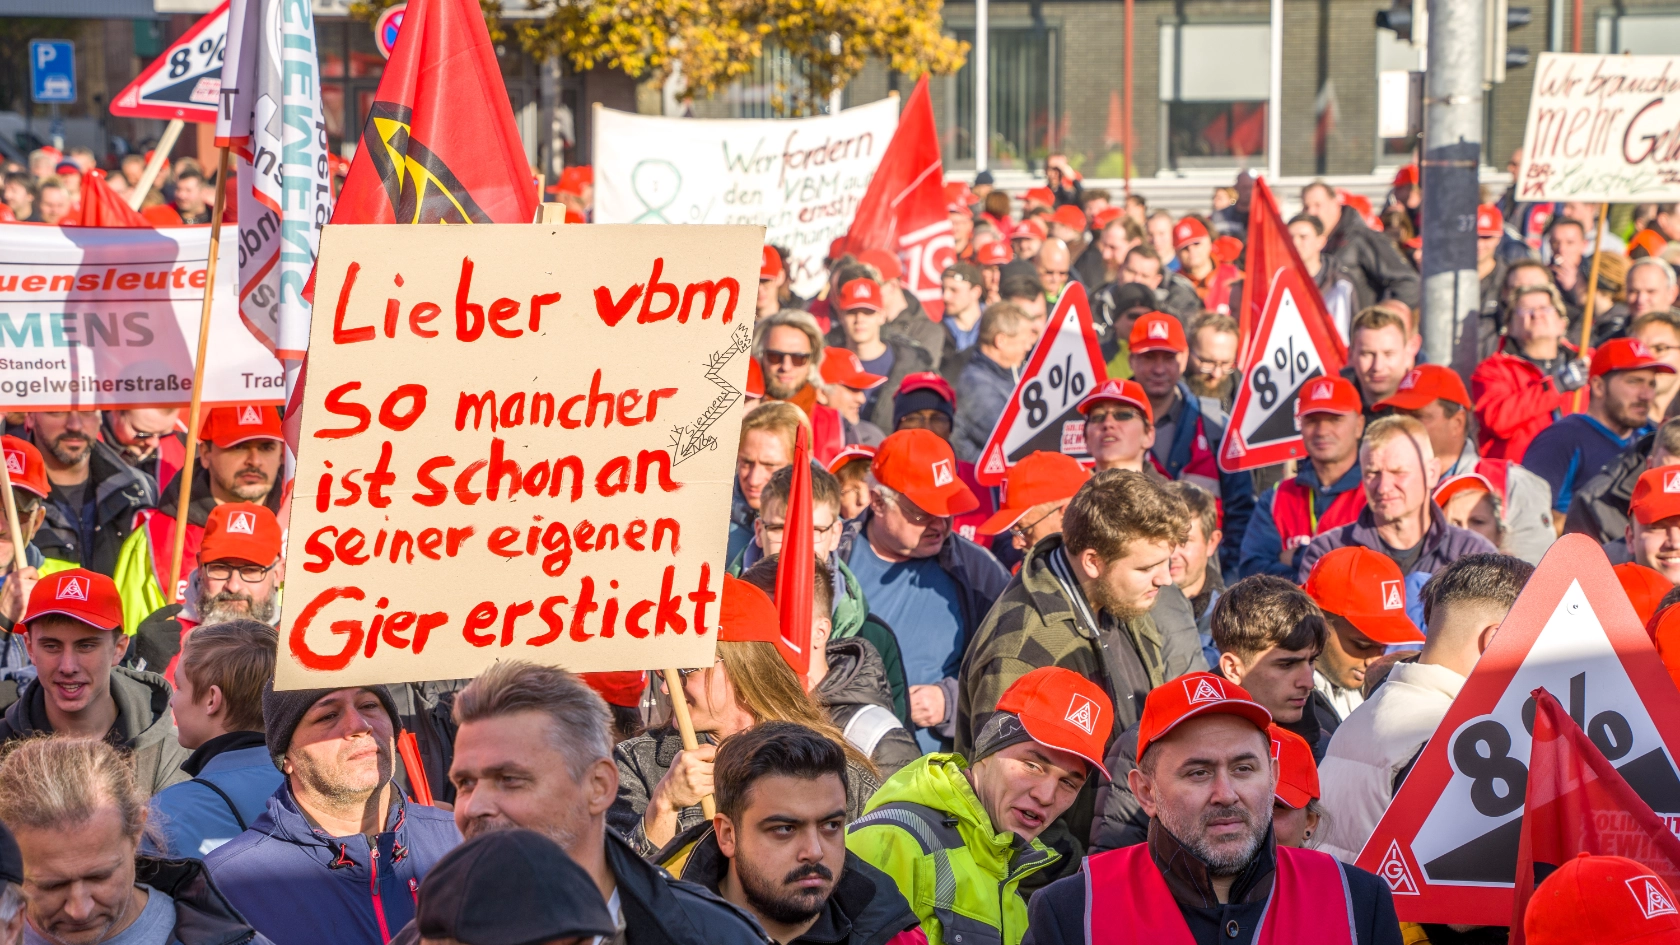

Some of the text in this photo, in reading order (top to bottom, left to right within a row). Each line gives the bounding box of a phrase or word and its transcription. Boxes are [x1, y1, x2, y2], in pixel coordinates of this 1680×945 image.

[37, 44, 57, 70] P
[778, 129, 874, 188] fordern
[1531, 92, 1625, 160] mehr
[724, 182, 763, 205] den
[784, 170, 840, 203] VBM
[0, 311, 155, 348] MENS
[333, 257, 561, 344] Lieber
[594, 258, 740, 326] vbm
[0, 358, 67, 370] Standort
[1022, 352, 1085, 428] 8%
[1252, 335, 1309, 410] 8%
[455, 369, 678, 432] mancher
[316, 440, 396, 512] ist
[595, 450, 680, 497] an
[303, 516, 680, 577] seiner eigenen
[289, 563, 716, 670] Gier erstickt
[1453, 671, 1634, 817] 8%
